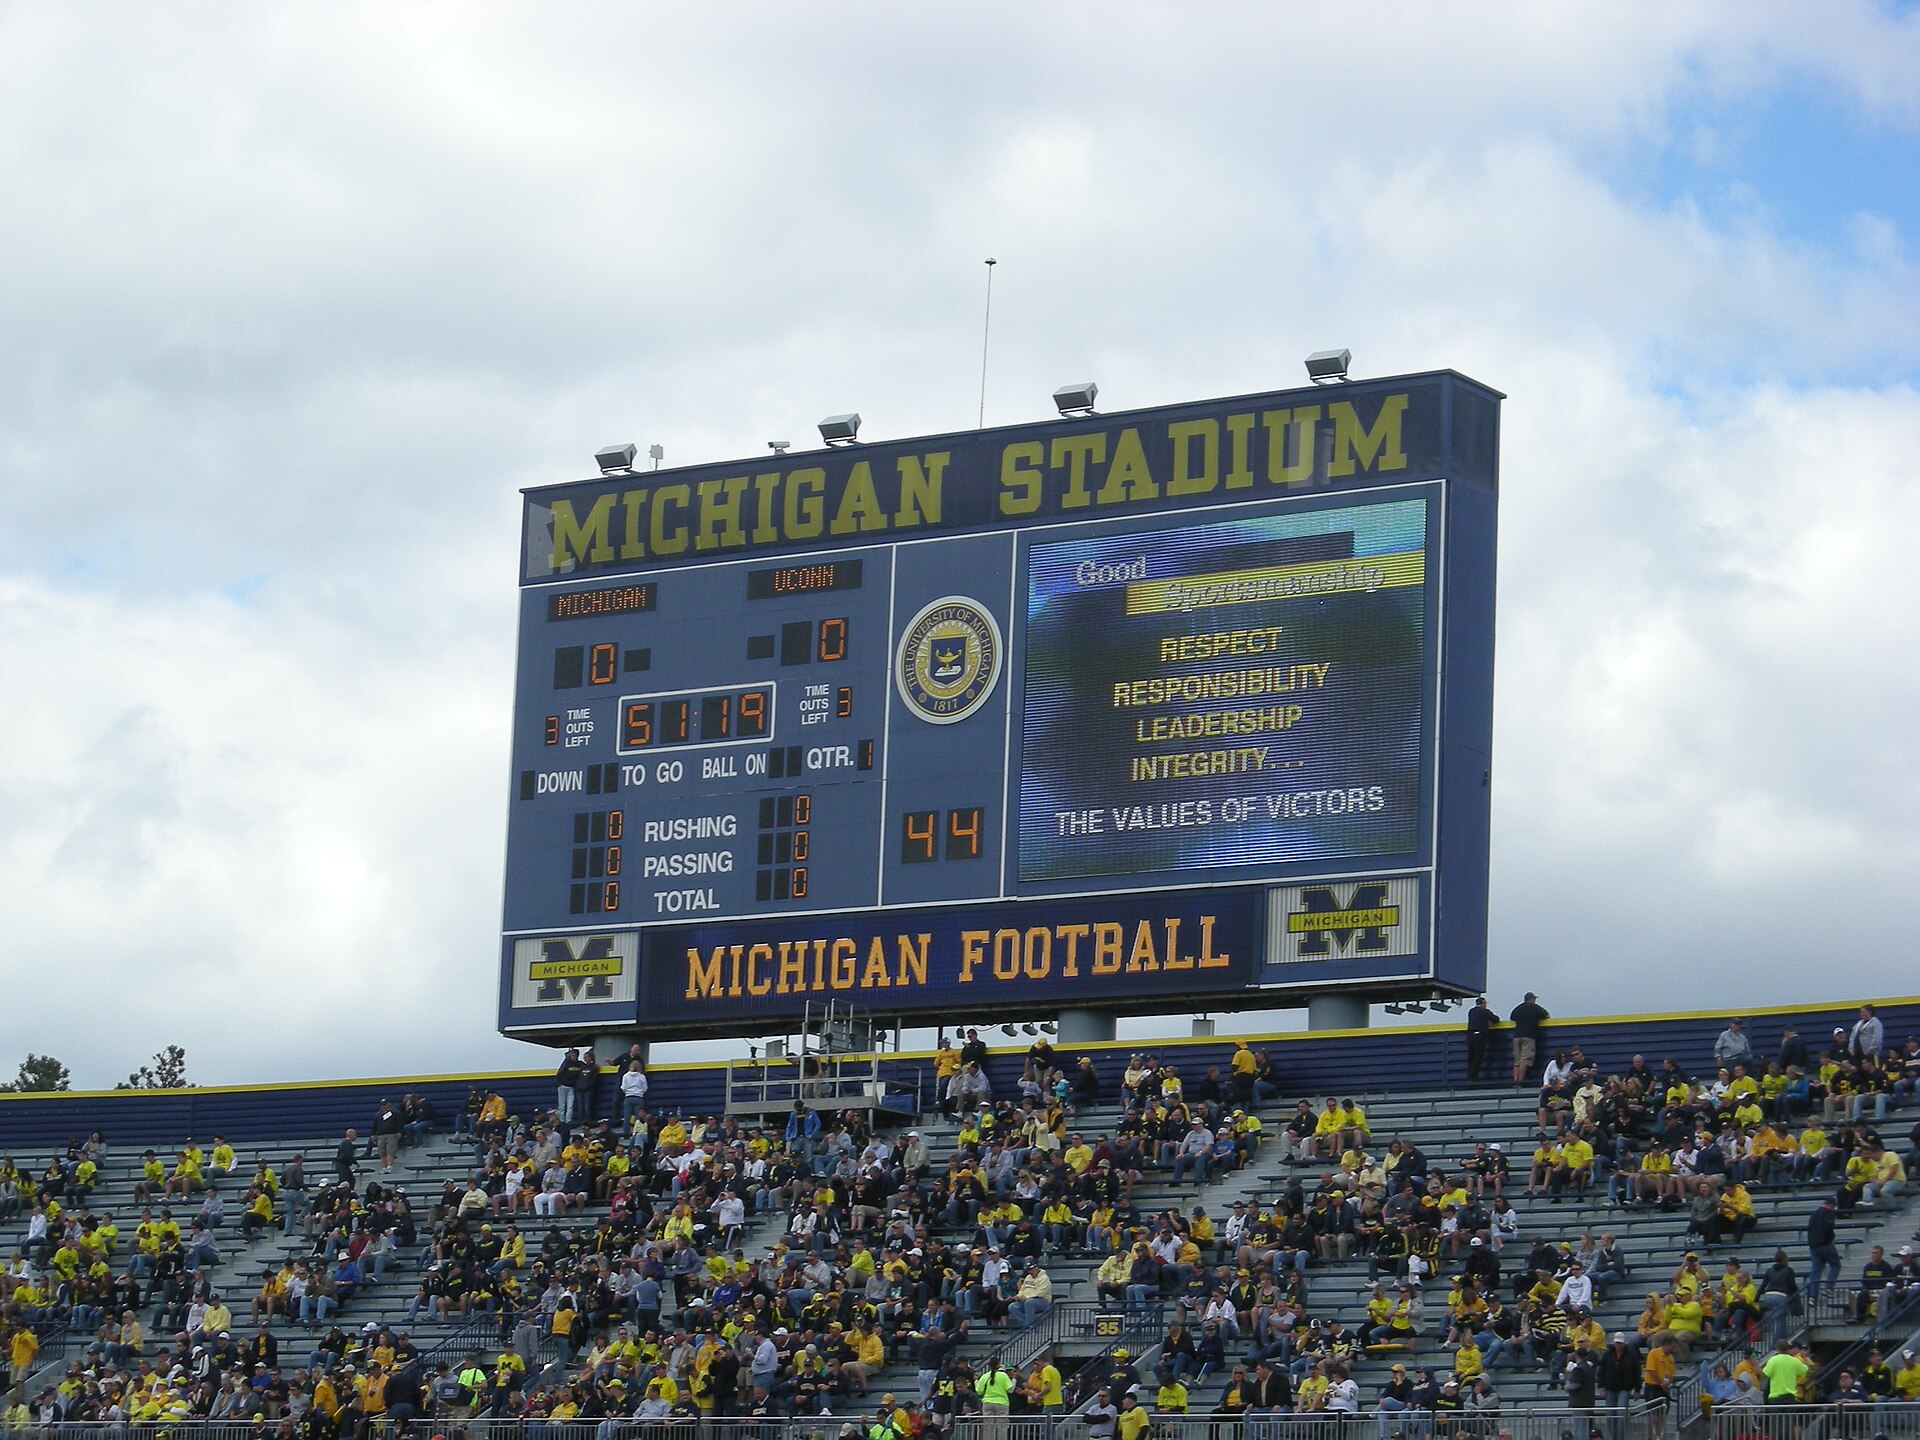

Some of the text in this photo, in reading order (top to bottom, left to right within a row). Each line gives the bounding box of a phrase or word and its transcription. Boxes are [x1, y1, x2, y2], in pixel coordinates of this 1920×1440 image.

[548, 393, 1409, 568] MICHIGAN STADIUM
[557, 586, 647, 617] MICHIGAN
[821, 619, 846, 661] 0
[905, 608, 957, 660] UNIVERSITY
[1160, 626, 1283, 661] RESPECT
[591, 643, 614, 685] 0
[970, 616, 993, 685] MICHIGAN
[805, 684, 830, 698] TIME
[906, 664, 917, 690] THE
[1113, 662, 1331, 708] RESPONSIBILITY
[567, 708, 591, 721] TIME
[799, 698, 829, 712] OUTS
[801, 711, 829, 726] LEFT
[933, 698, 959, 712] 1817
[566, 721, 595, 735] OUTS
[1136, 705, 1303, 742] LEADERSHIP
[565, 734, 592, 749] LEFT
[702, 752, 767, 779] BALL ON
[806, 746, 855, 770] QTR.
[537, 771, 584, 795] DOWN
[622, 761, 684, 787] TO GO
[795, 794, 811, 824] 0
[1055, 785, 1385, 836] THE VALUES OF VICTORS
[609, 811, 623, 840] 0
[644, 814, 738, 843] RUSHING
[793, 831, 809, 860] 0
[607, 846, 621, 876] 0
[643, 850, 734, 878] PASSING
[792, 867, 807, 896] 0
[605, 882, 619, 911] 0
[654, 888, 720, 914] TOTAL
[1303, 911, 1384, 927] MICHIGAN
[543, 962, 609, 976] MICHIGAN
[685, 914, 1230, 1000] MICHIGAN FOOTBALL
[1096, 1321, 1119, 1335] 35
[938, 1380, 954, 1396] 54
